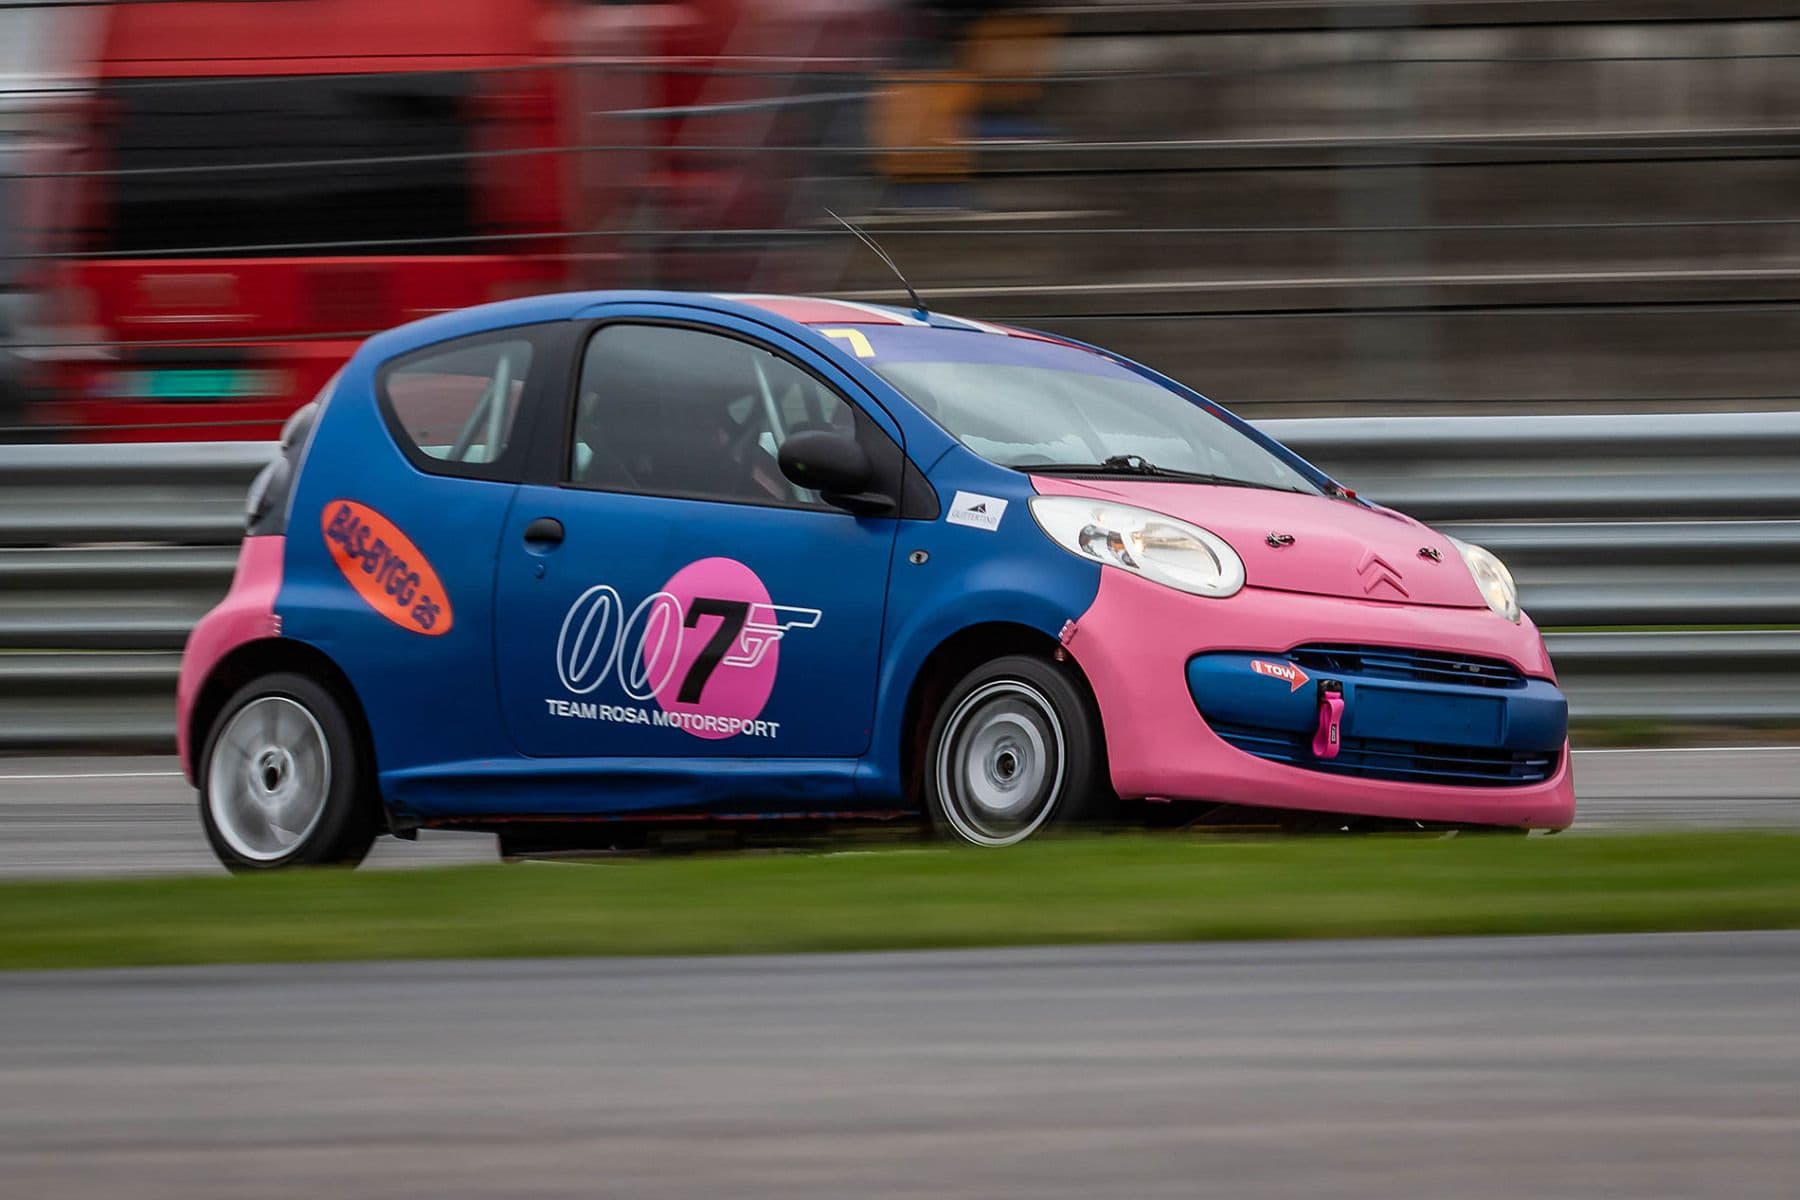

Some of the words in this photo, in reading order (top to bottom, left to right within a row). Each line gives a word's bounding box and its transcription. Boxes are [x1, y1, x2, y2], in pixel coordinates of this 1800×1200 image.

[327, 504, 420, 606] BAS-BYGG
[1264, 663, 1296, 680] TOW
[545, 699, 597, 719] TEAM
[600, 705, 650, 725] ROSA
[653, 710, 780, 738] MOTORSPORT
